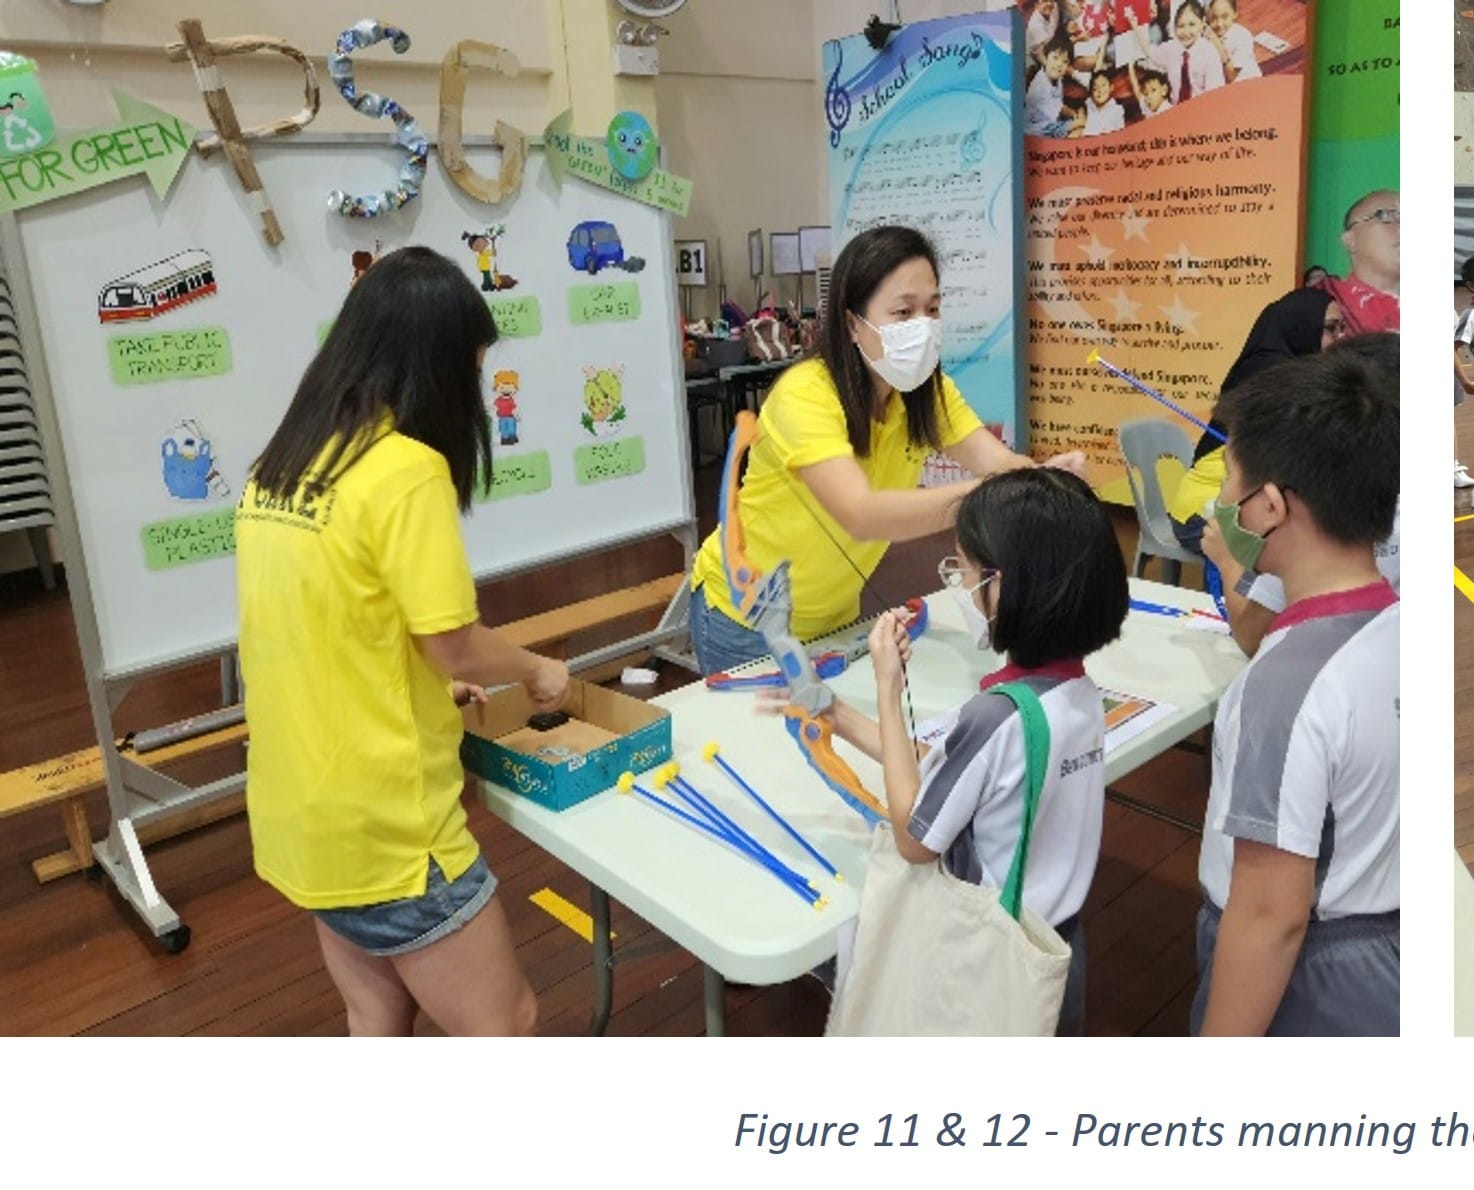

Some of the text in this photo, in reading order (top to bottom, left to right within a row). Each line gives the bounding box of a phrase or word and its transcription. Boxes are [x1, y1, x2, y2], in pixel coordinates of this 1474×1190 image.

[1328, 57, 1392, 75] SO AS TO
[0, 118, 189, 200] FOR GREEN
